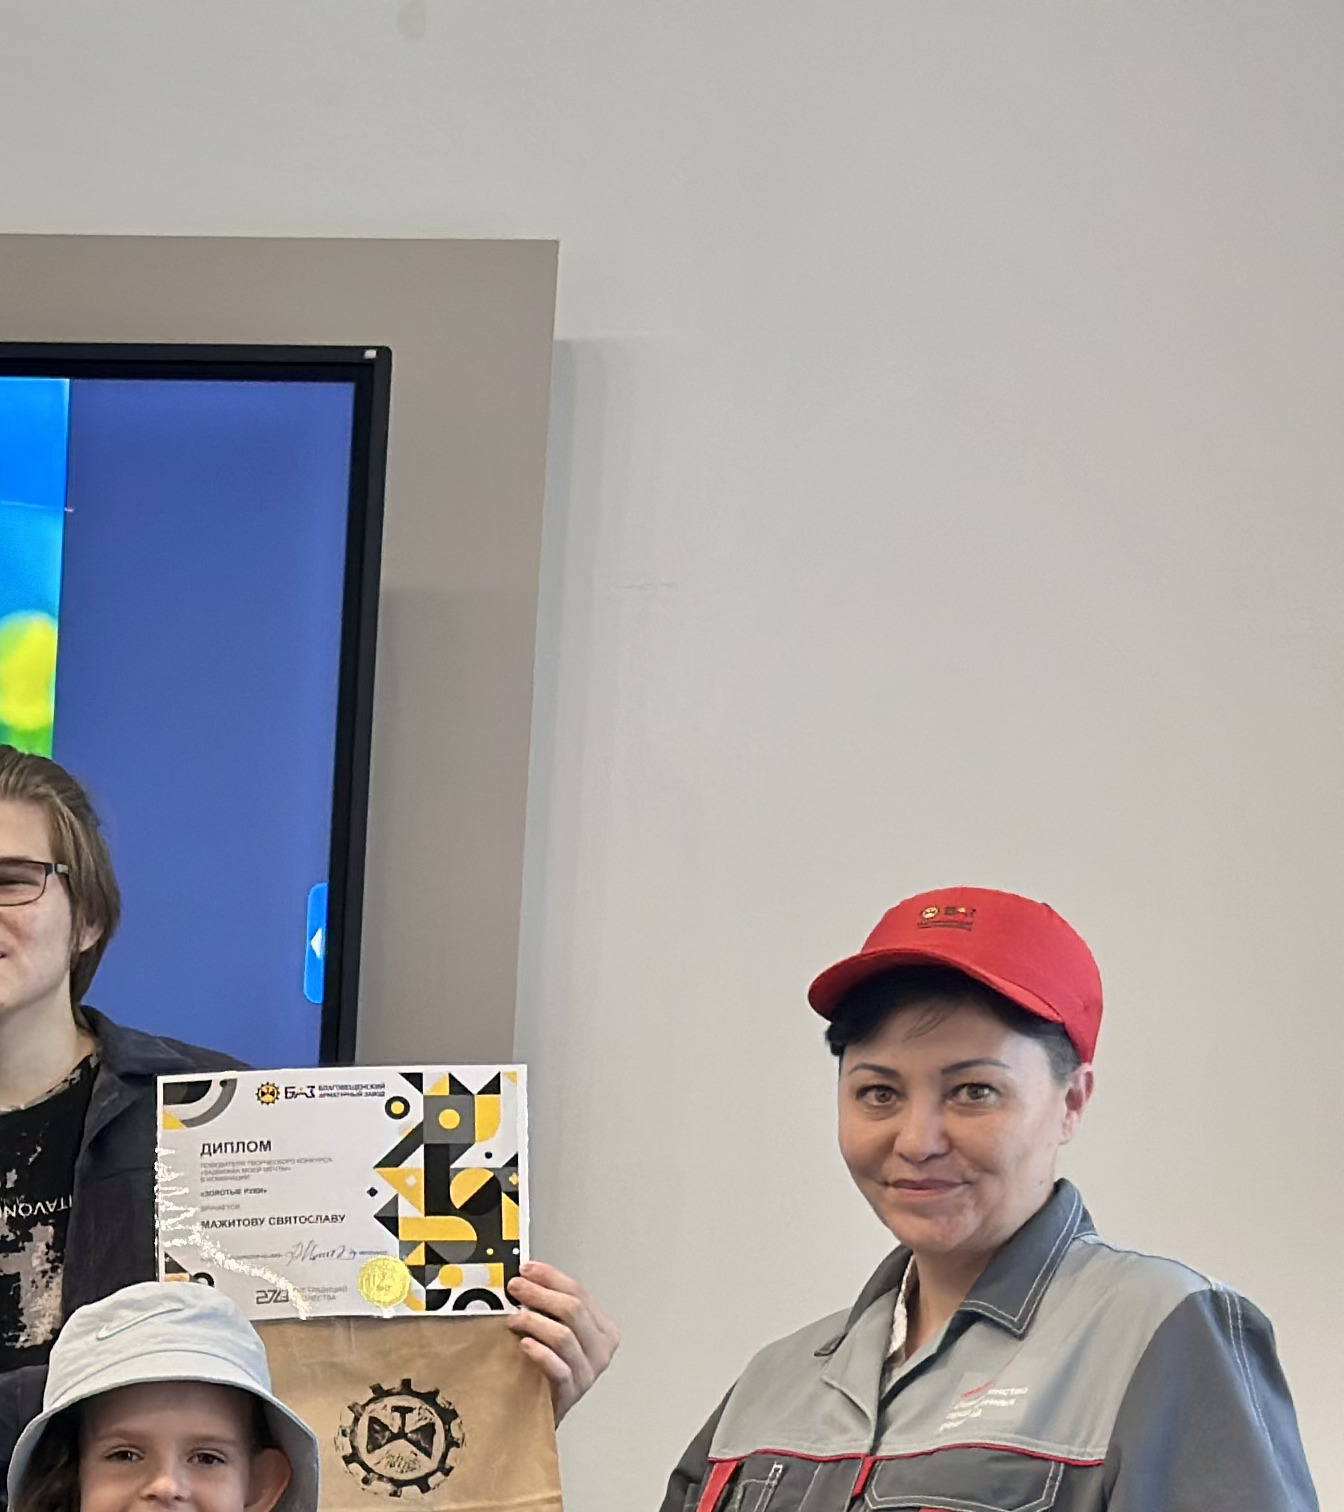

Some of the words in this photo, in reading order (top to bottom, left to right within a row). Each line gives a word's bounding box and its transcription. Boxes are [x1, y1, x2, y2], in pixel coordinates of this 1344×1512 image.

[200, 1139, 272, 1157] ДИПЛОМ
[201, 1217, 265, 1230] МАЖИТОВУ
[268, 1213, 346, 1226] СВЯТОСЛАВУ
